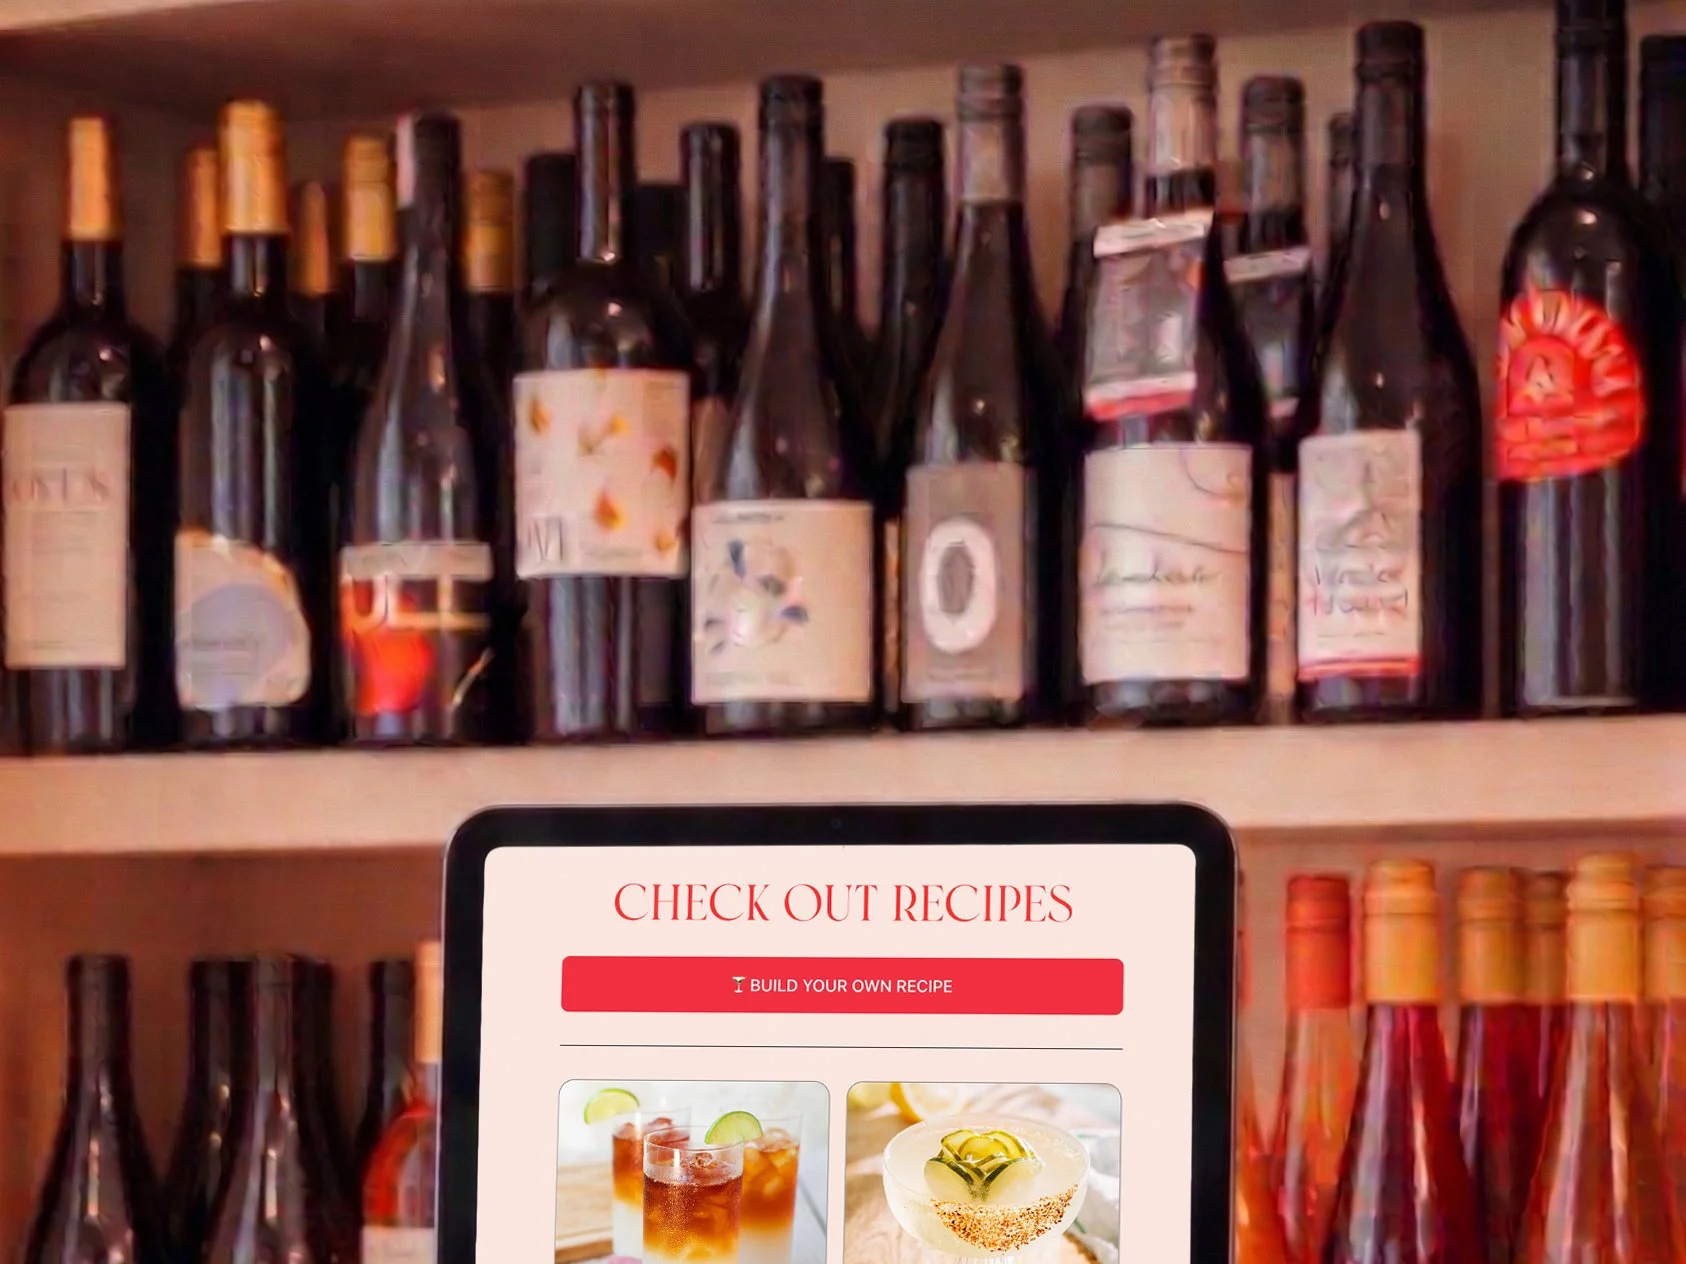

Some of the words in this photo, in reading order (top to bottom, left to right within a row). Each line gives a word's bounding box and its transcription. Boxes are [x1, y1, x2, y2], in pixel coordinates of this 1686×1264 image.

[614, 883, 770, 922] CHECK
[783, 883, 878, 922] OUT
[893, 884, 1073, 923] RECIPES
[750, 978, 798, 993] BUILD
[802, 978, 848, 993] YOUR
[851, 979, 892, 993] OWN
[896, 979, 953, 994] RECIPE
